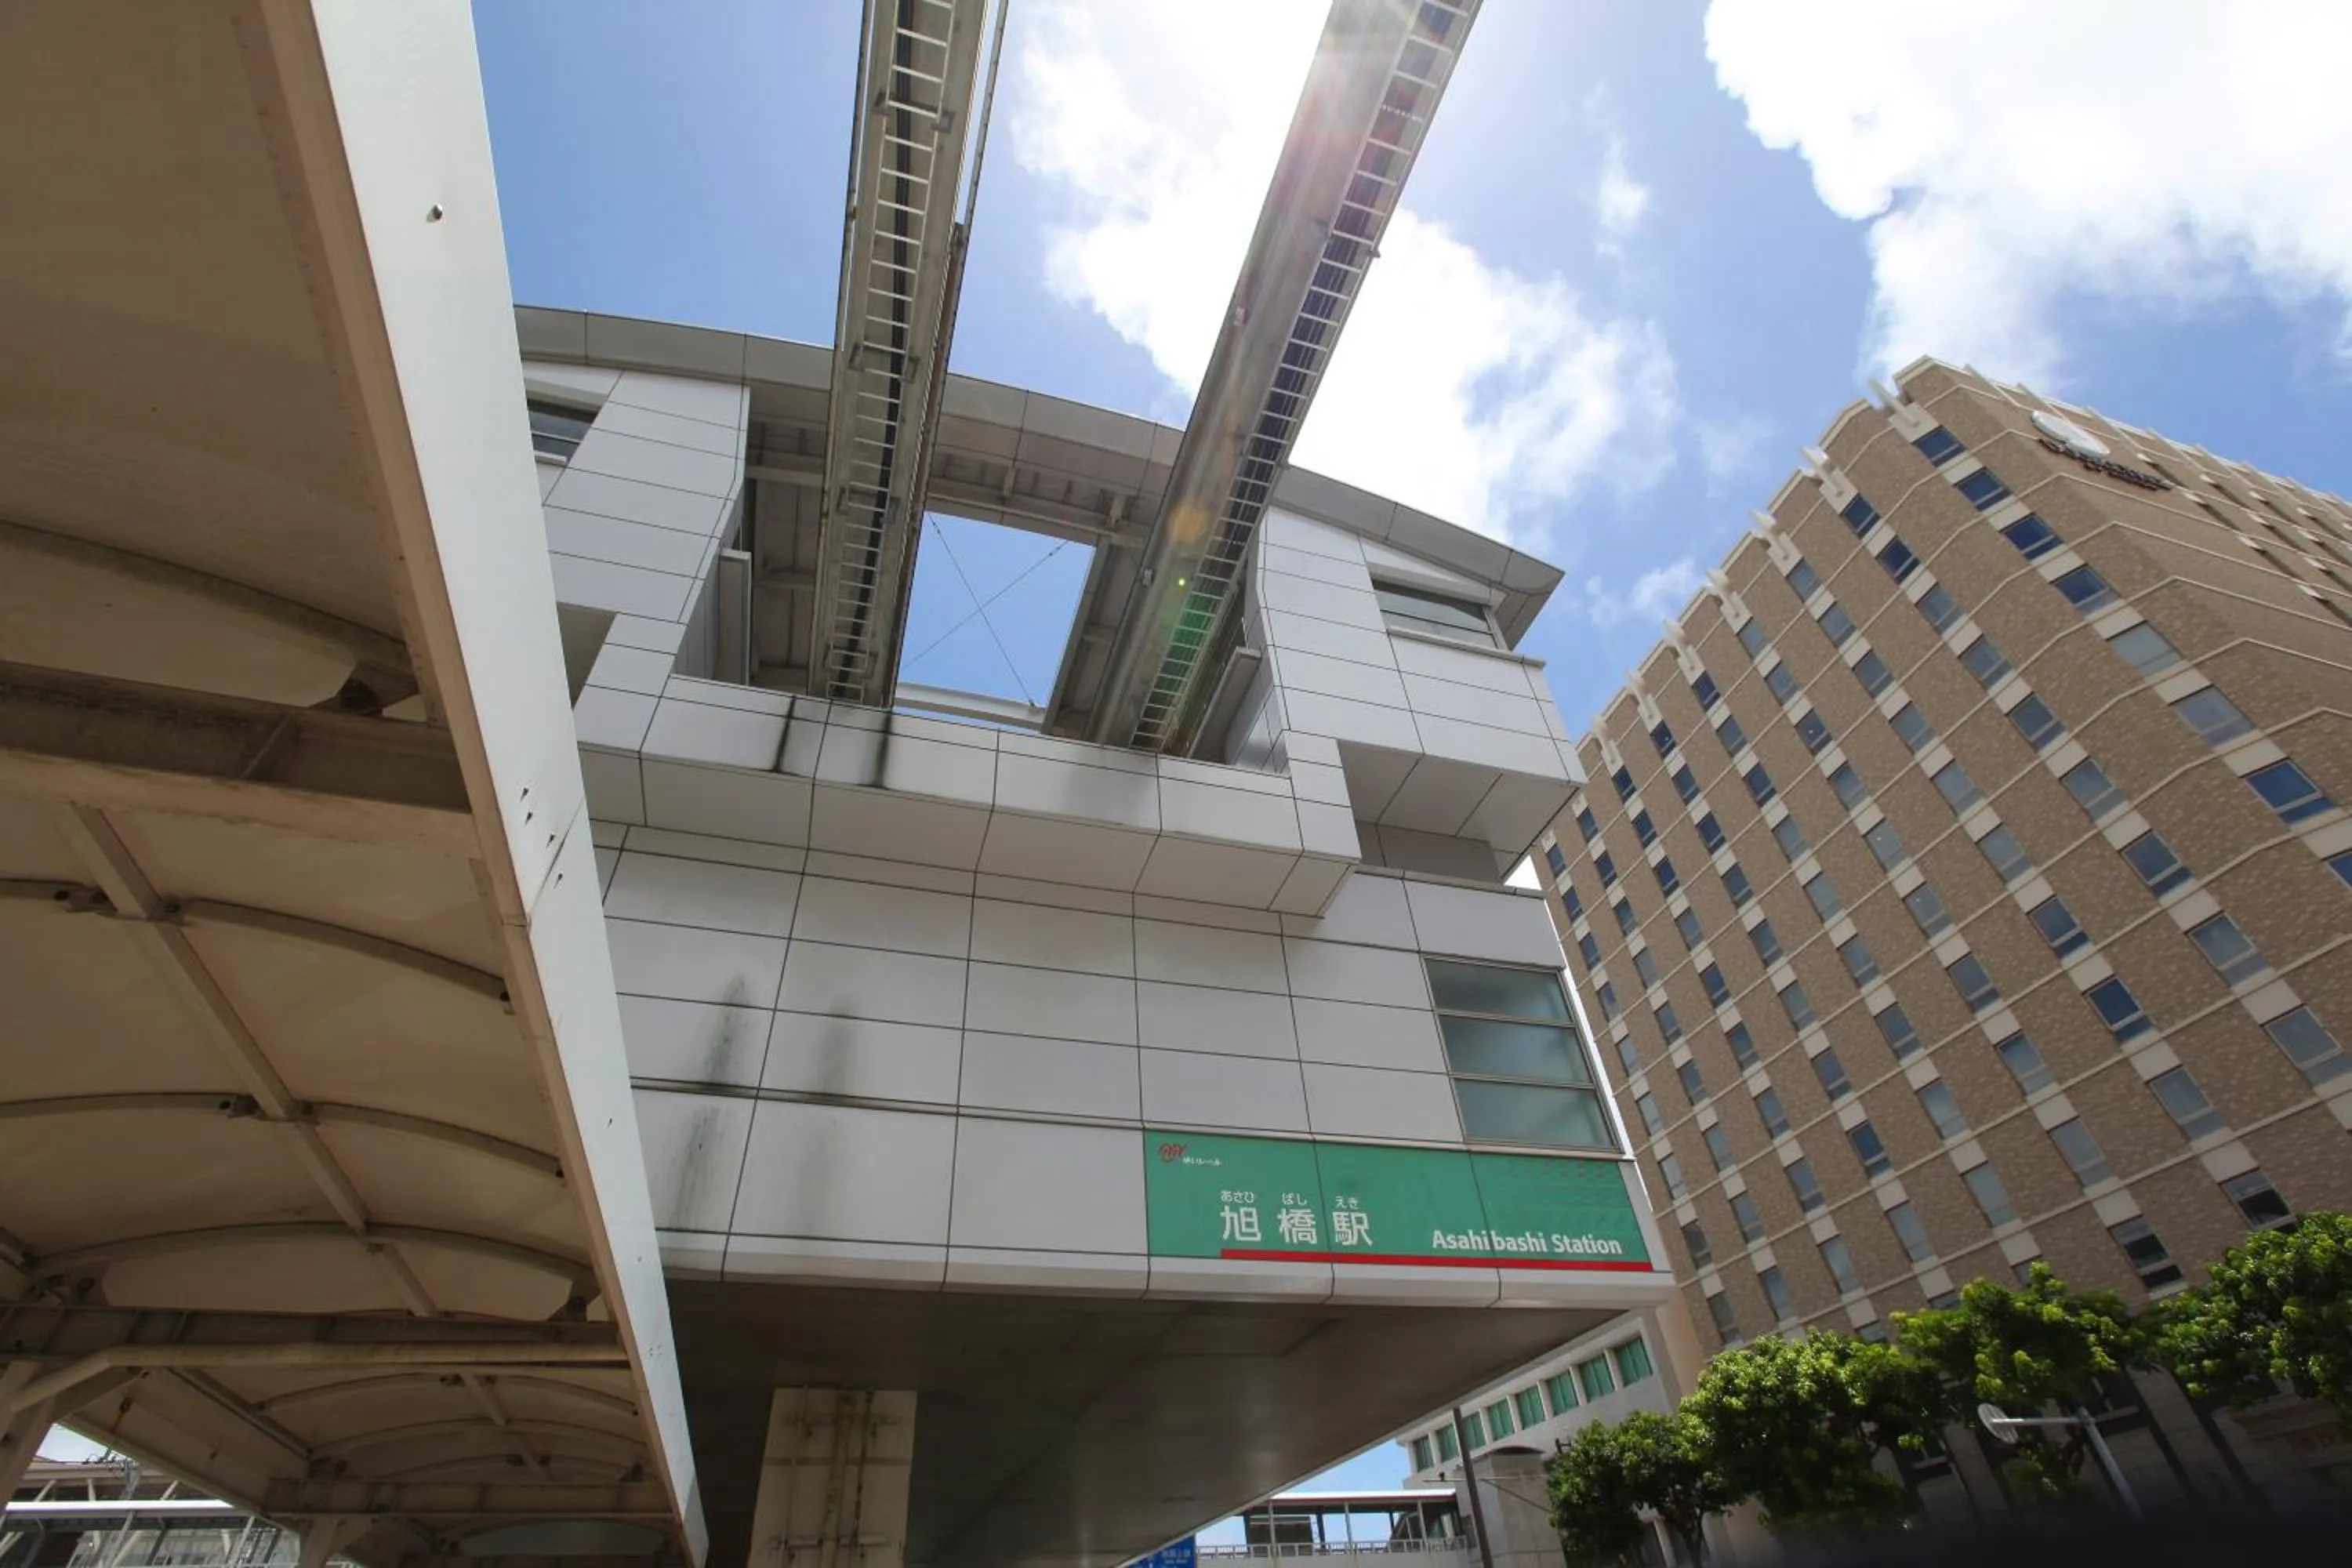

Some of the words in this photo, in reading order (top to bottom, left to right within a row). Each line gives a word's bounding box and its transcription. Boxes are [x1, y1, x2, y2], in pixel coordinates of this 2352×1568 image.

[1220, 1190, 1255, 1203] あさひ
[1282, 1192, 1307, 1205] ばし
[1335, 1196, 1361, 1210] えき
[1219, 1205, 1373, 1247] 旭橋駅
[1552, 1233, 1622, 1254] Station
